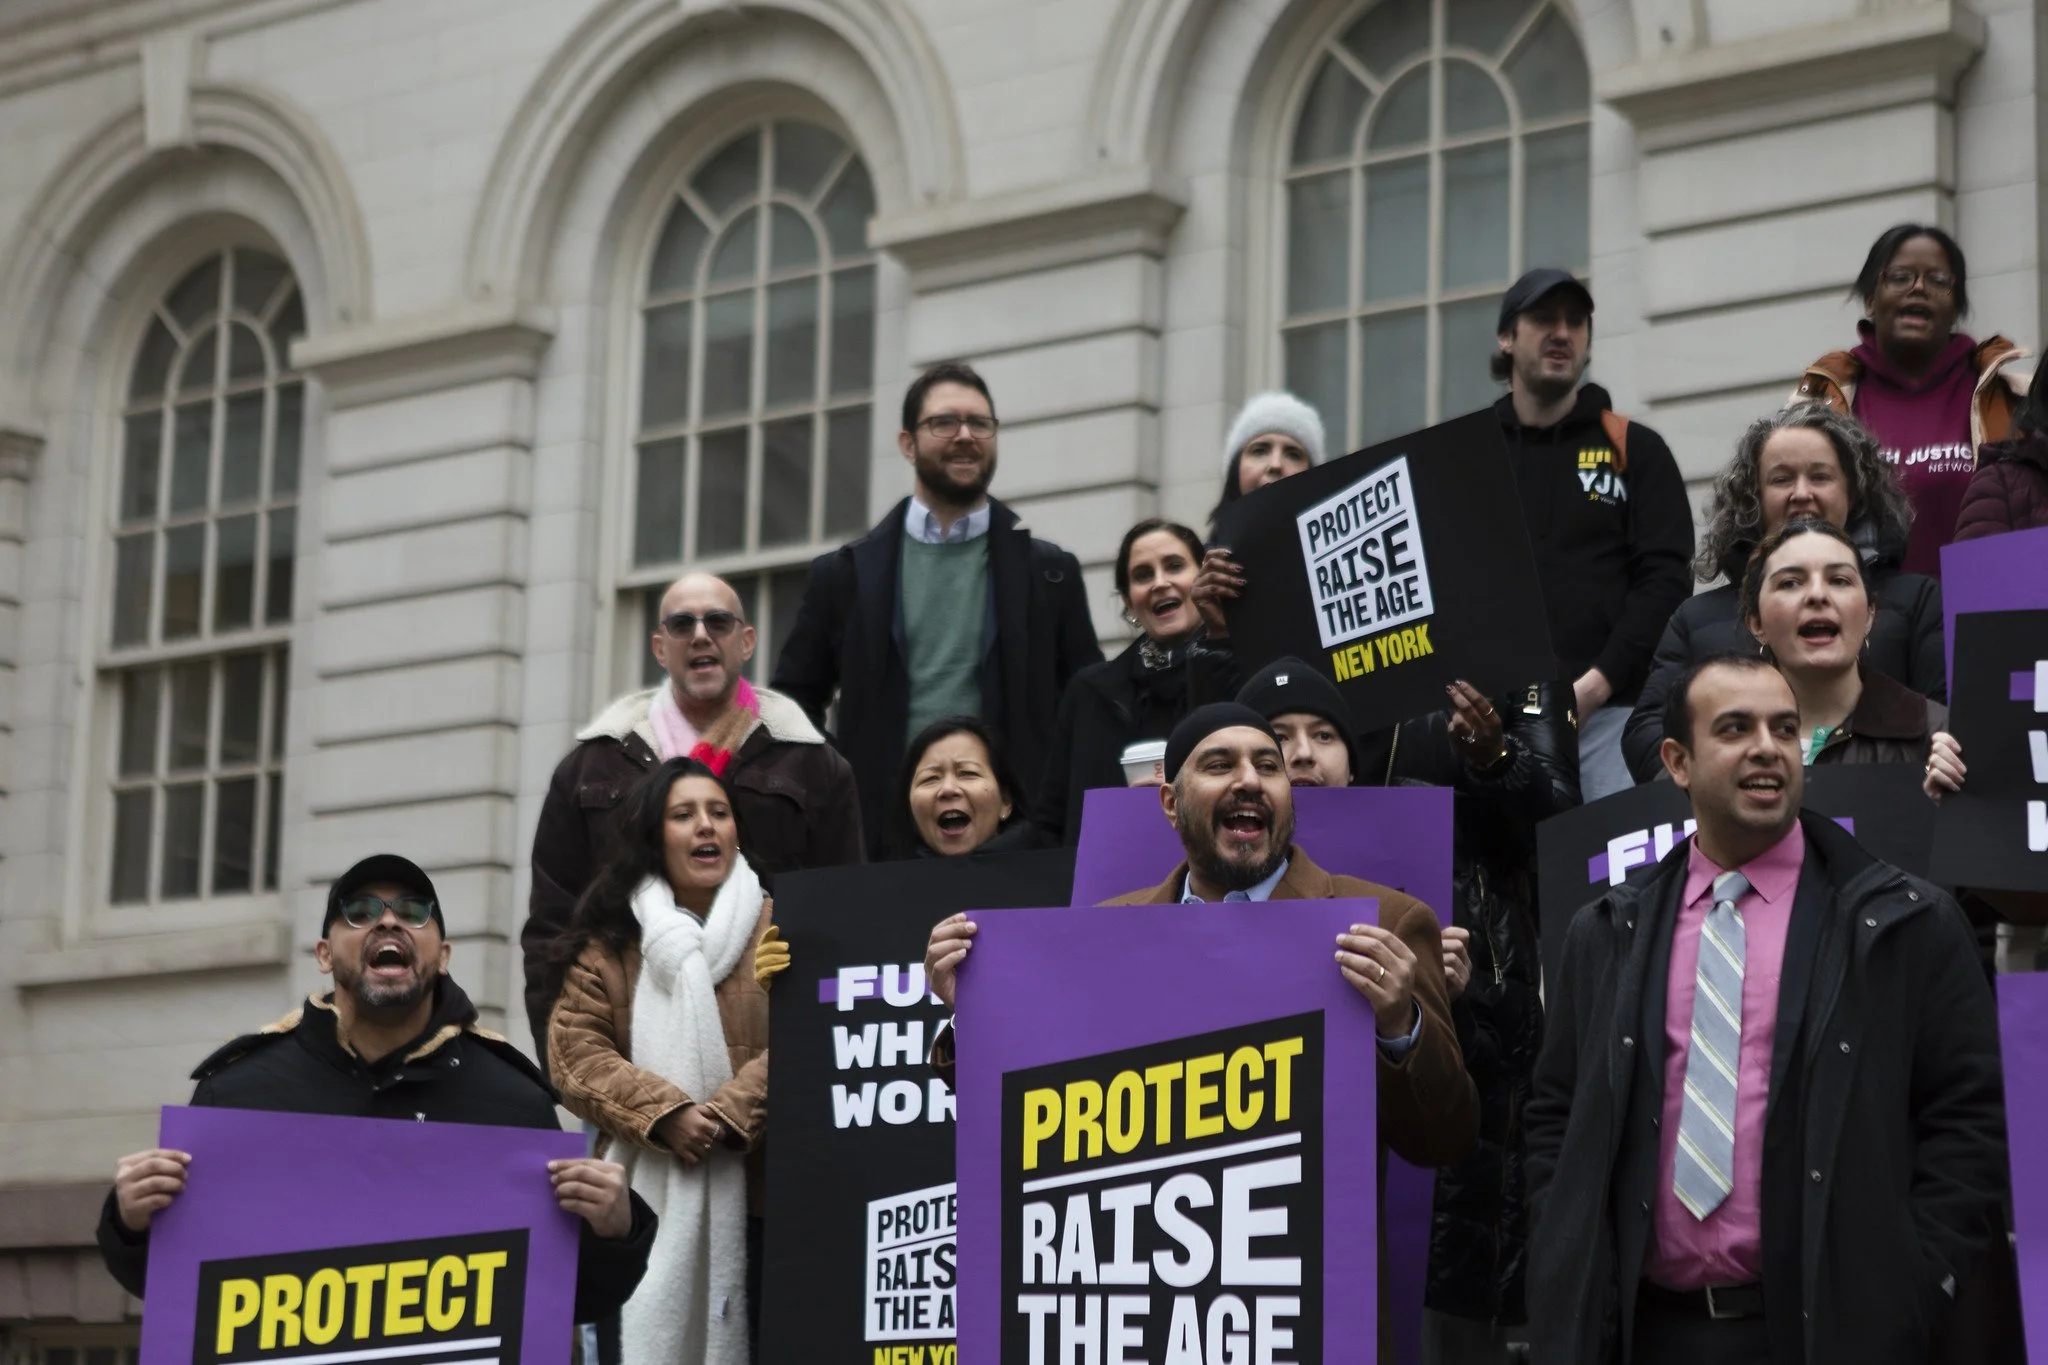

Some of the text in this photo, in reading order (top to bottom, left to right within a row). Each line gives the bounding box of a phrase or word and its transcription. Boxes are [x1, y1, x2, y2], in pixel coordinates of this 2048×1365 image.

[1905, 443, 1973, 466] JUSTIC
[1928, 462, 1975, 474] NETWO
[1307, 471, 1401, 554] PROTECT
[1316, 518, 1417, 601] RAISE
[1322, 574, 1424, 637] THE AGE
[1332, 623, 1434, 683] NEW YORK
[837, 962, 945, 1012] FU
[831, 1078, 957, 1129] WOR
[1023, 1036, 1303, 1171] PROTECT
[878, 1193, 957, 1243] PROTE
[1023, 1154, 1302, 1287] RAISE
[876, 1242, 957, 1292] RAIS
[215, 1250, 508, 1355] PROTECT
[874, 1294, 956, 1331] THE A
[1018, 1292, 1301, 1365] THE AGE
